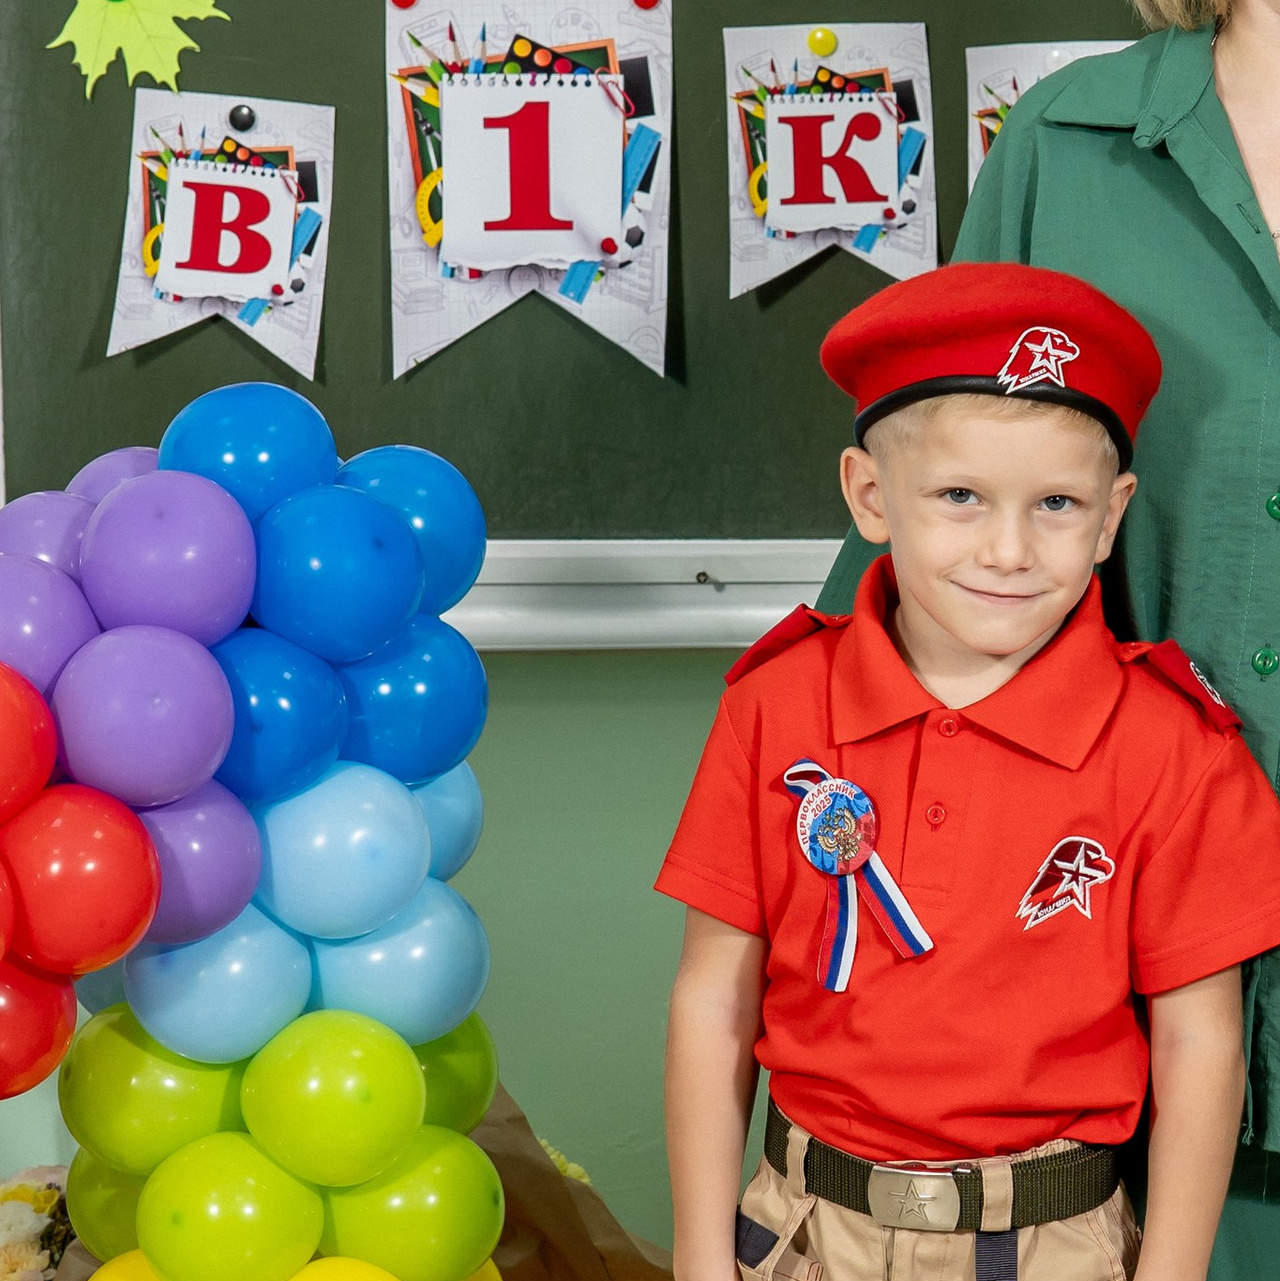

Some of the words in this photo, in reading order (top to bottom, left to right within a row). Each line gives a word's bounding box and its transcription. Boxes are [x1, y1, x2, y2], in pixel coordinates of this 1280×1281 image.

[174, 180, 273, 275] В
[483, 100, 574, 232] 1
[799, 782, 856, 845] ПЕРВОКЛАССНИК
[810, 795, 832, 818] 2025
